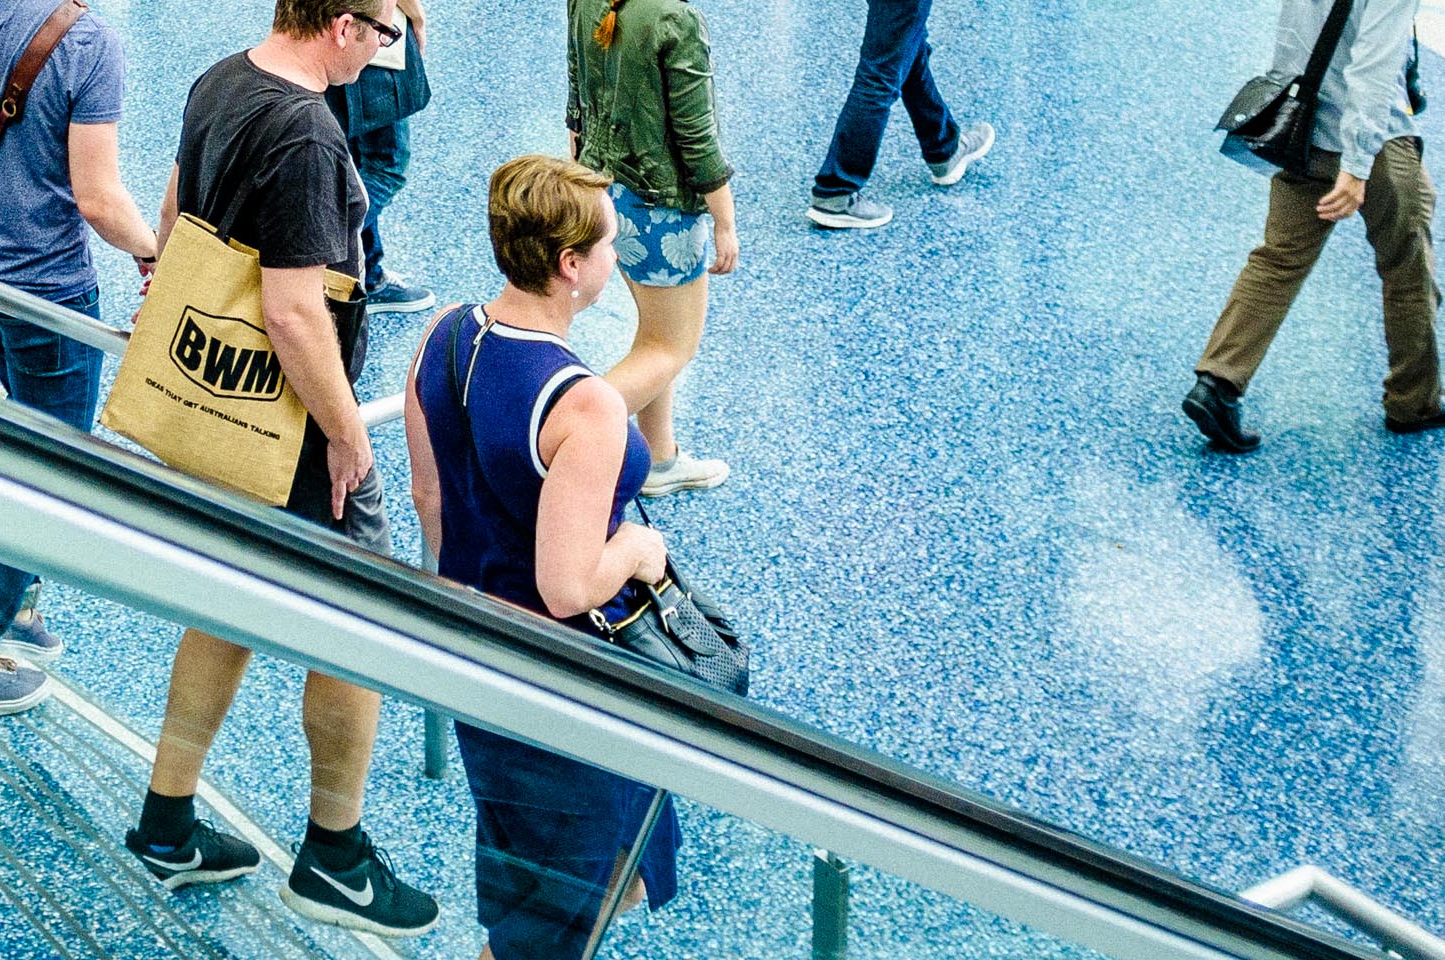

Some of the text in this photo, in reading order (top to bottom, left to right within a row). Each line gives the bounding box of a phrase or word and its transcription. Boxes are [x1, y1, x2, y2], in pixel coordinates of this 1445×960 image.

[175, 316, 282, 394] BWM
[145, 377, 280, 441] IDEAS THAT GET AUSTRALIANS TALKING
